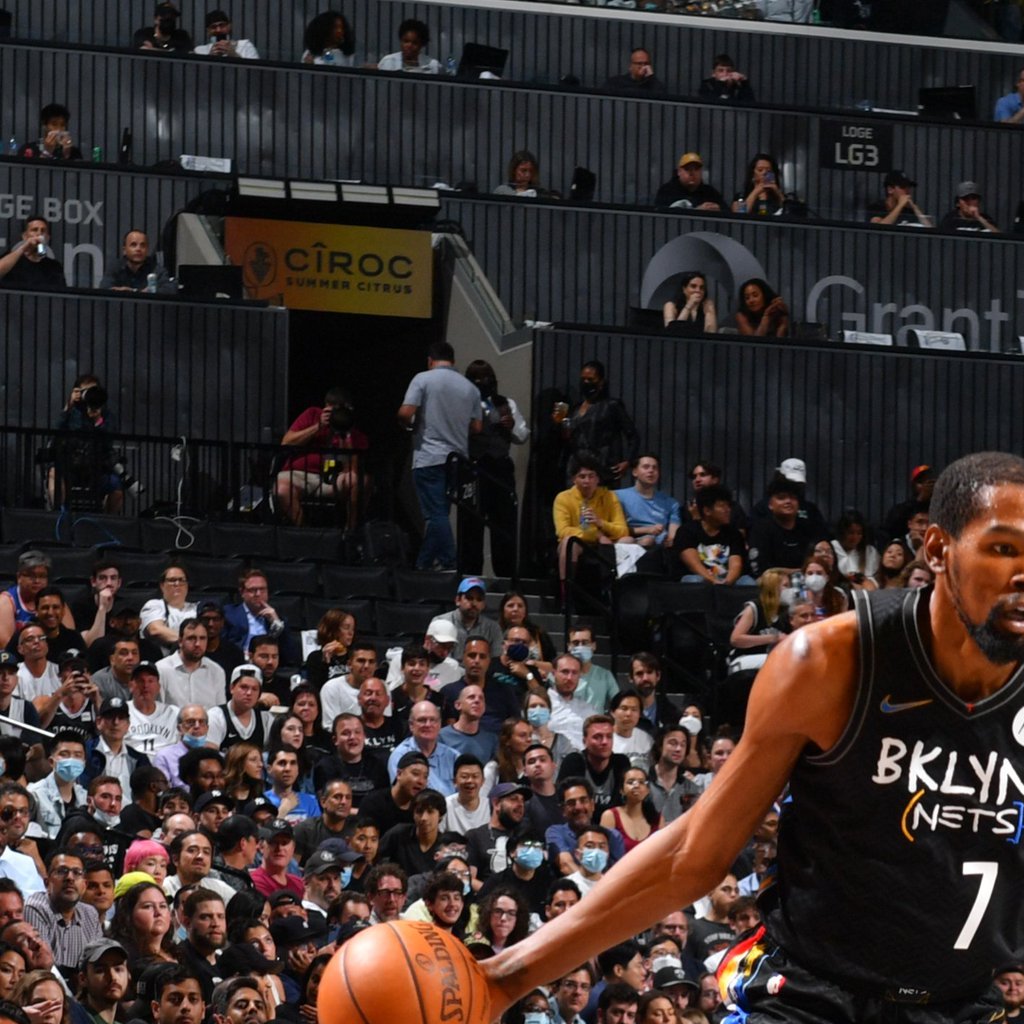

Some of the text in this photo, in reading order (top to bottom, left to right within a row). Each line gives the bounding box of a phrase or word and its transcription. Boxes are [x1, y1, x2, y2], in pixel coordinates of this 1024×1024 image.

[841, 125, 874, 140] LOGE
[834, 141, 880, 167] LG3
[43, 197, 104, 226] BOX
[286, 276, 413, 295] SUMMER CITRUS
[806, 275, 1009, 352] Grant
[953, 861, 999, 950] 7
